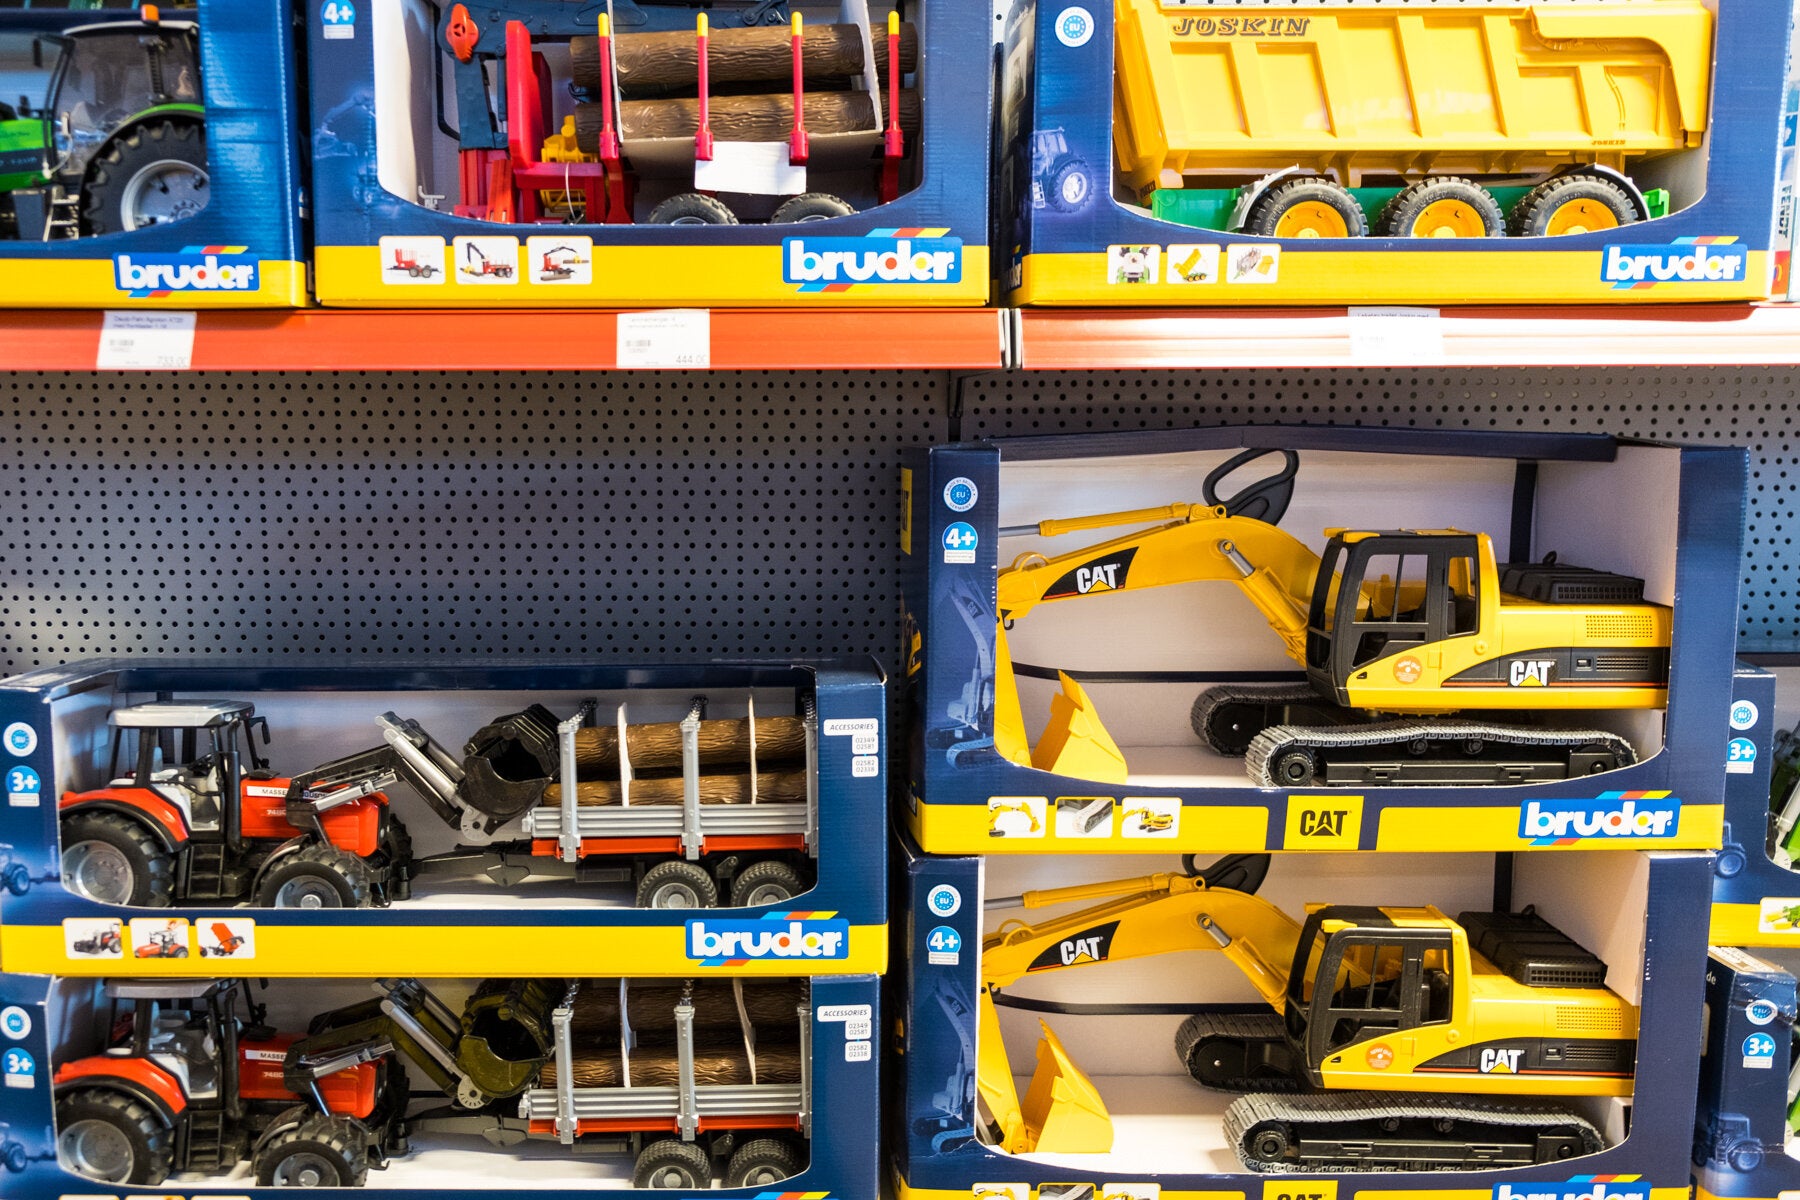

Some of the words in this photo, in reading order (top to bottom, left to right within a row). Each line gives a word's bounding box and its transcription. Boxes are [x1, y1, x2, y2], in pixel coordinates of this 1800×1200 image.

[324, 2, 354, 24] 4+
[1069, 23, 1081, 31] EU
[1172, 17, 1311, 36] JOSKIN
[790, 240, 955, 281] bruder
[1606, 246, 1742, 281] bruder
[118, 255, 254, 289] bruder
[945, 528, 975, 549] 4+
[1076, 563, 1119, 594] CAT
[1510, 660, 1552, 687] CAT
[830, 723, 874, 731] ACCESSORIES
[1729, 742, 1755, 761] 3+
[11, 771, 39, 792] 3+
[1300, 809, 1348, 837] CAT
[1525, 801, 1673, 836] bruder
[939, 897, 950, 905] EU
[692, 922, 842, 957] bruder
[929, 931, 959, 951] 4+
[1060, 936, 1101, 966] CAT
[1747, 1037, 1773, 1056] 3+
[8, 1053, 33, 1073] 3+
[1480, 1048, 1522, 1074] CAT
